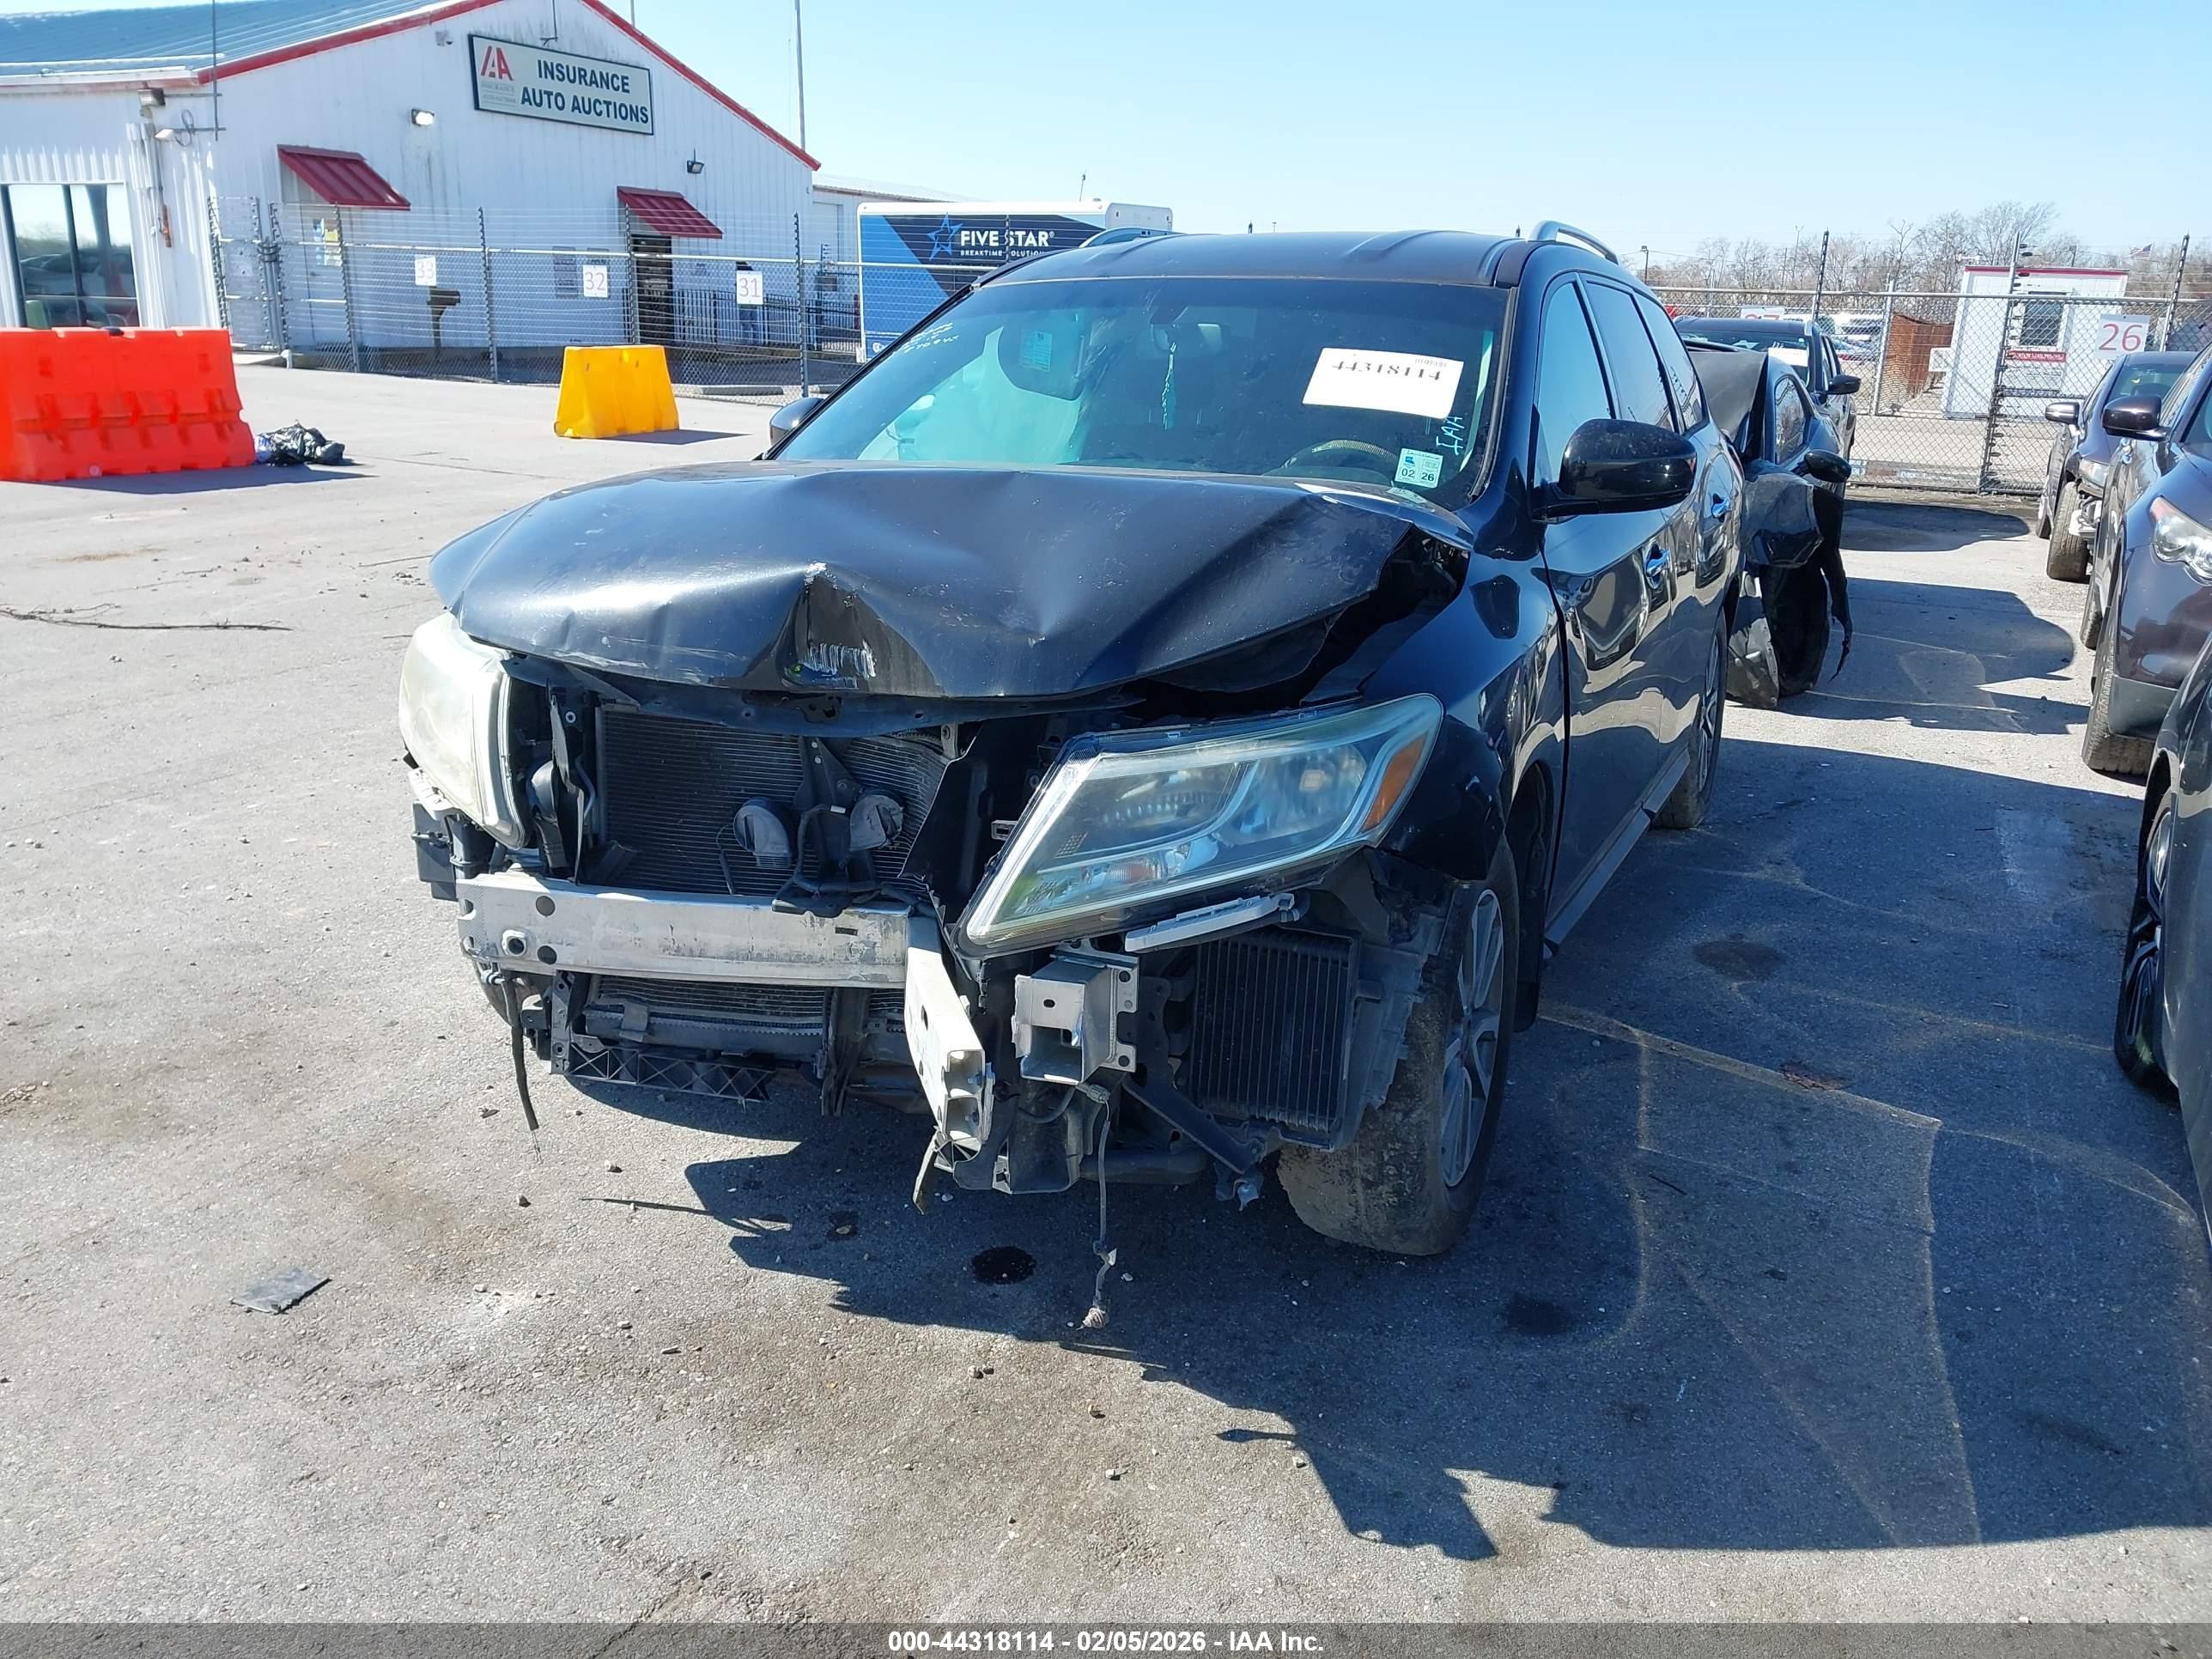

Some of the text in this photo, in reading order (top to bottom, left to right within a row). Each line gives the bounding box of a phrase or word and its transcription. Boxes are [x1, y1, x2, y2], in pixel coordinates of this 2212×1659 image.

[538, 59, 630, 94] INSURANCE
[520, 87, 649, 124] AUTO AUCTIONS
[961, 230, 1000, 246] FIVE
[416, 260, 434, 279] 33
[585, 271, 605, 291] 32
[739, 277, 760, 298] 31
[2099, 323, 2143, 351] 26
[1401, 468, 1435, 482] 02 26
